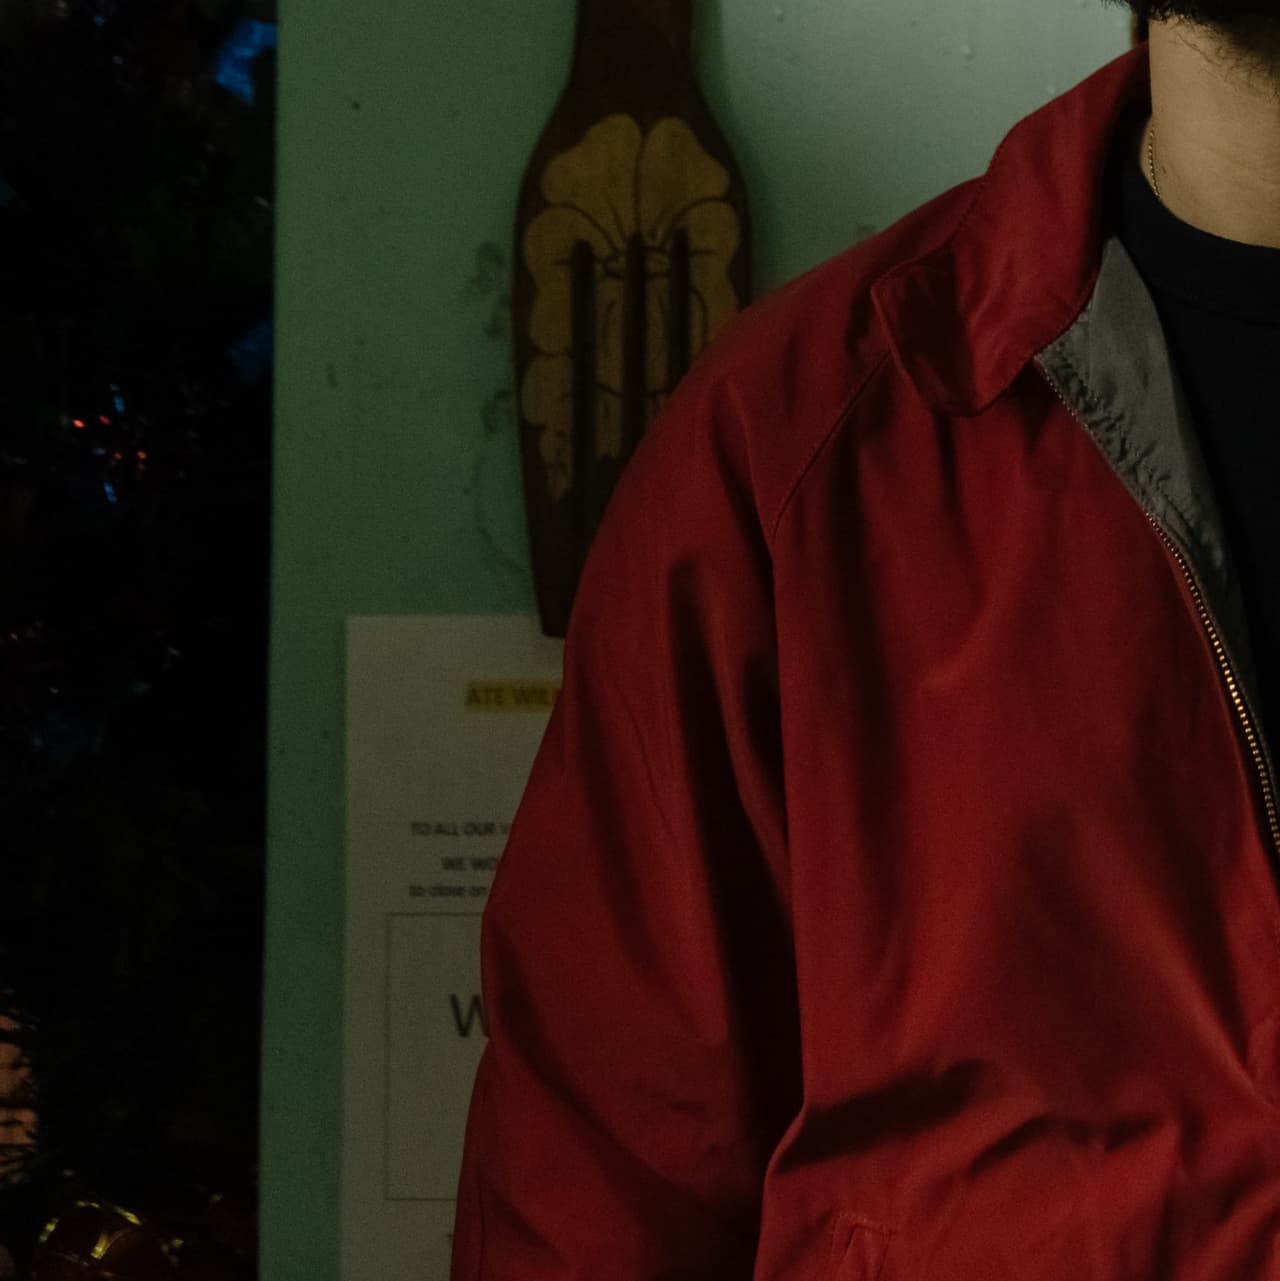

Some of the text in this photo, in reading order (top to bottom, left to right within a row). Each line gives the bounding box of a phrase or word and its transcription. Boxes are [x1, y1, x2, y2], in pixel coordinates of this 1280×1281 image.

[410, 822, 432, 835] TO
[434, 822, 459, 835] ALL
[464, 822, 496, 835] OUR
